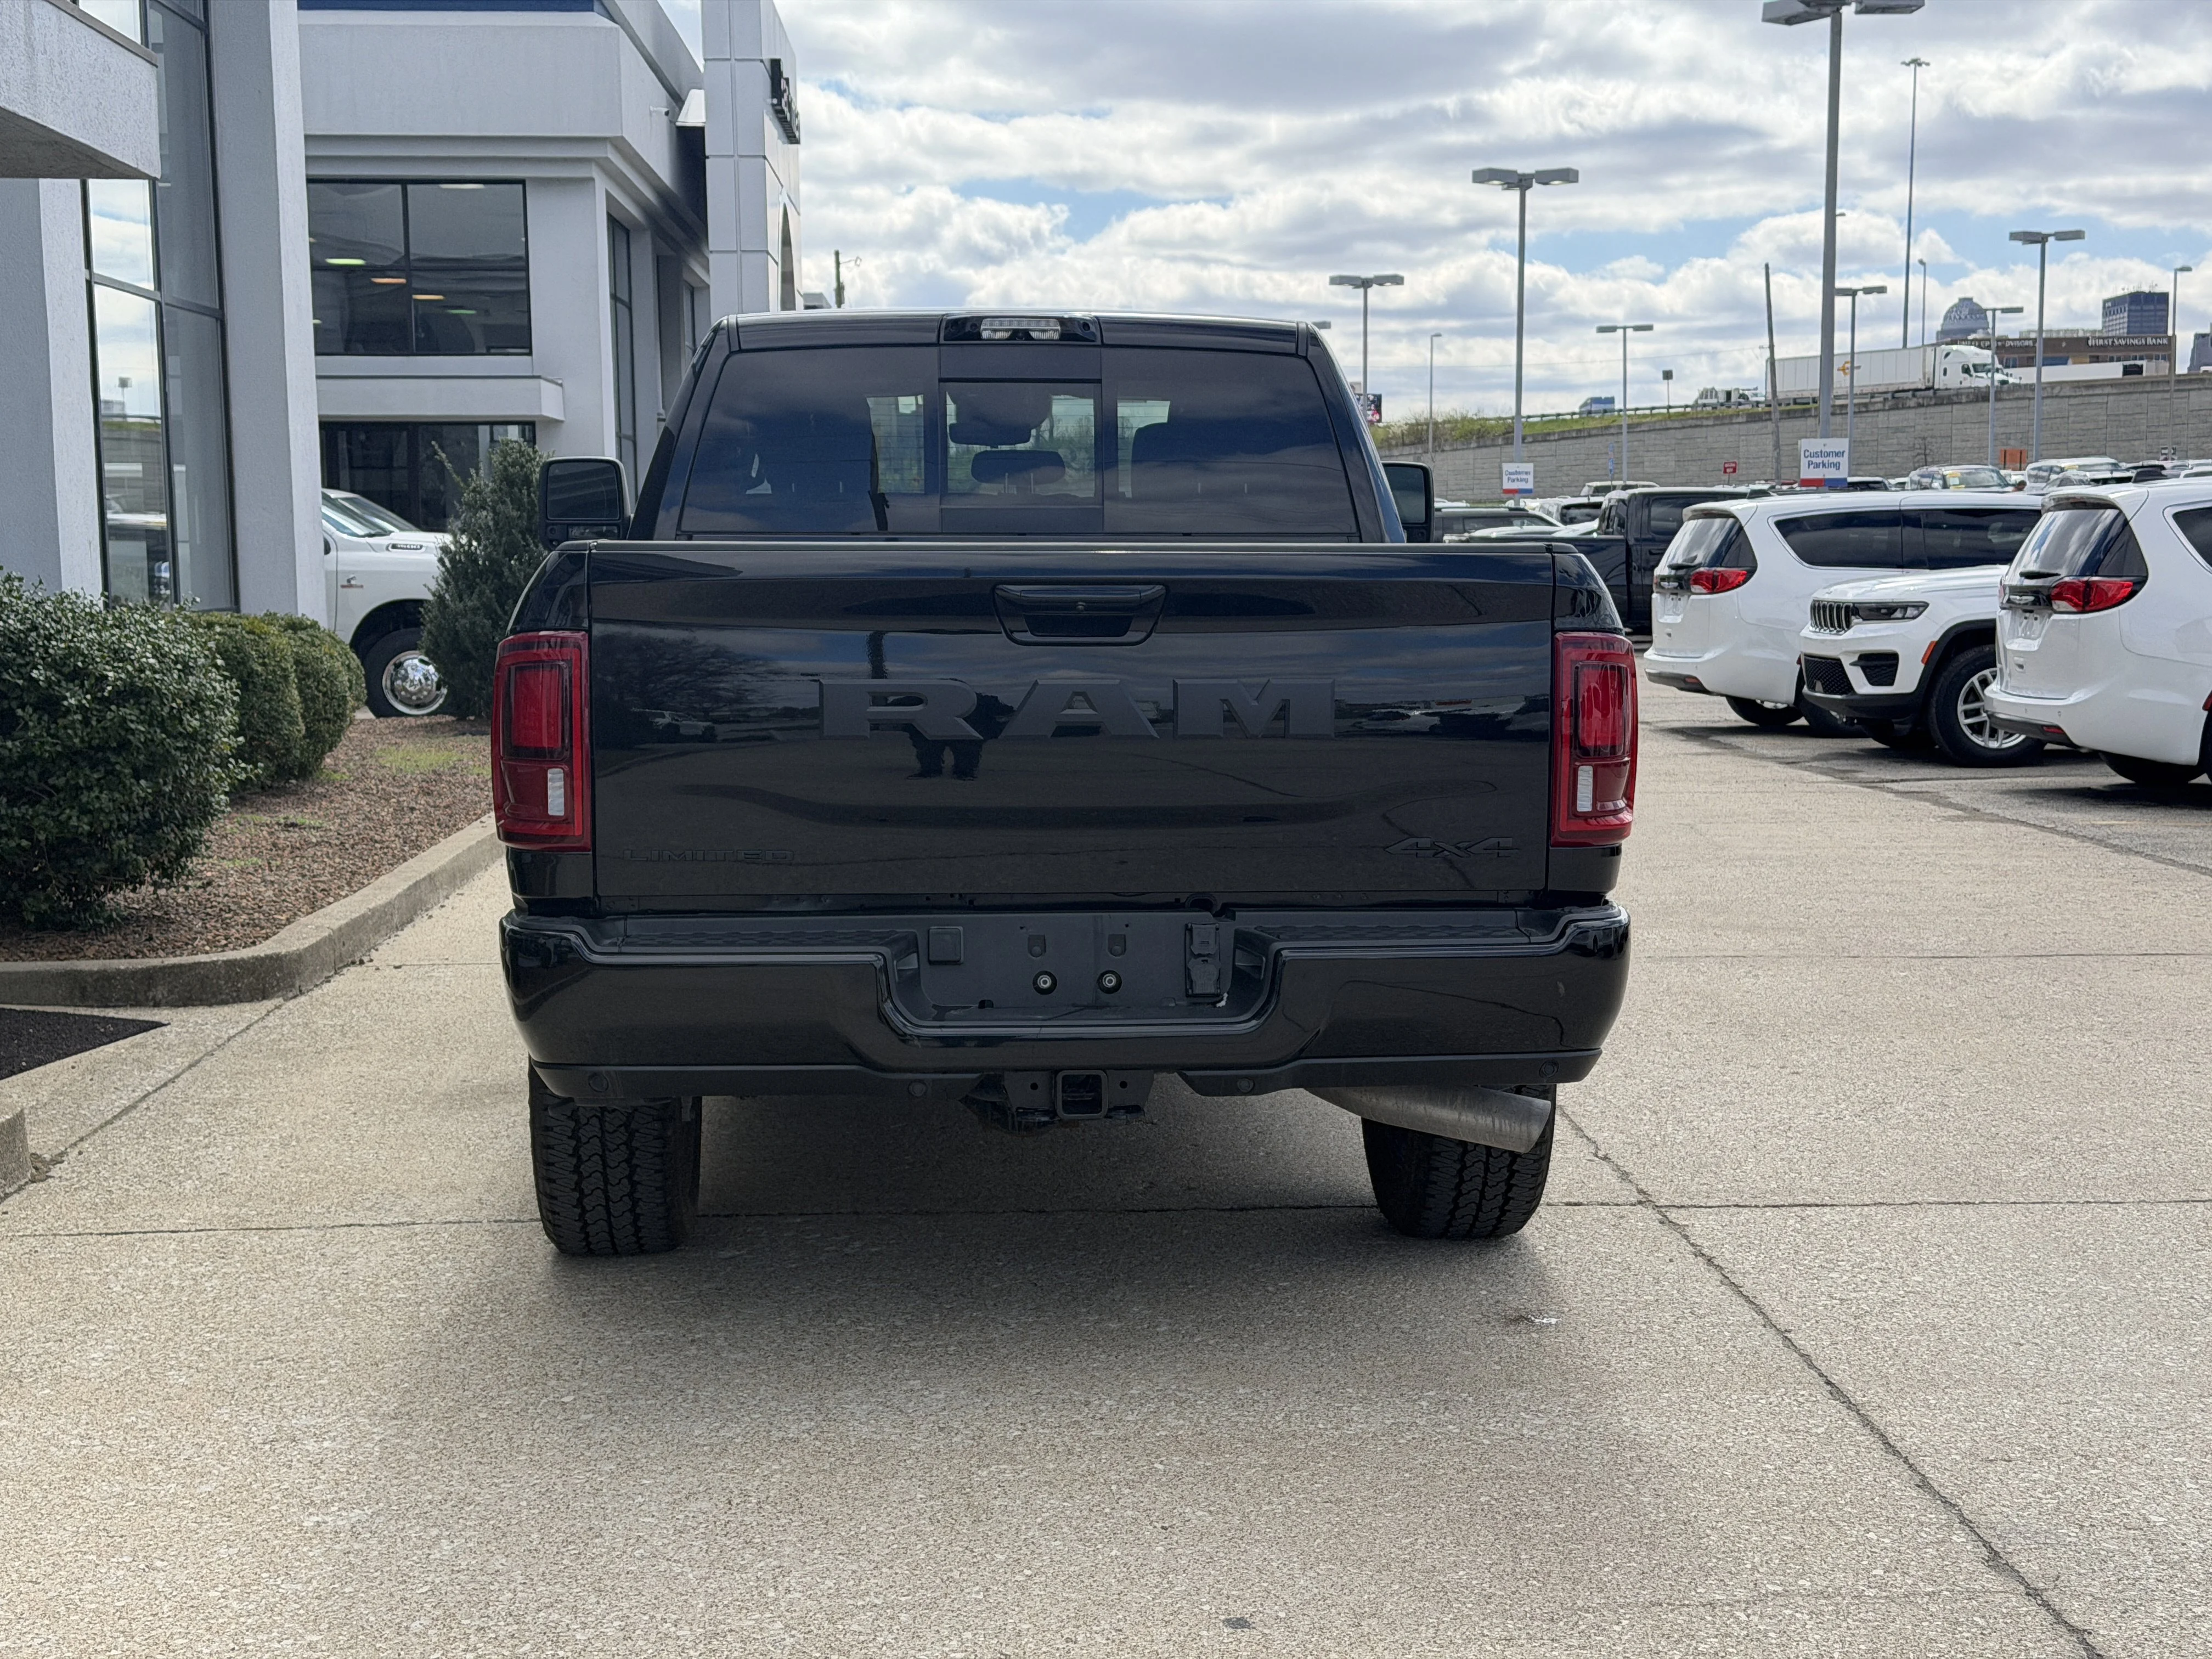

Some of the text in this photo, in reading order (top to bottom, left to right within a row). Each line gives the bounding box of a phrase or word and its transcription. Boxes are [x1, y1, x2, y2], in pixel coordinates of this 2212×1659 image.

[2092, 336, 2169, 347] FIRST SAVINGS BANK
[1803, 449, 1846, 459] Customer
[1807, 460, 1841, 471] Parking
[819, 679, 1335, 740] RAM
[623, 849, 794, 861] LIMITED
